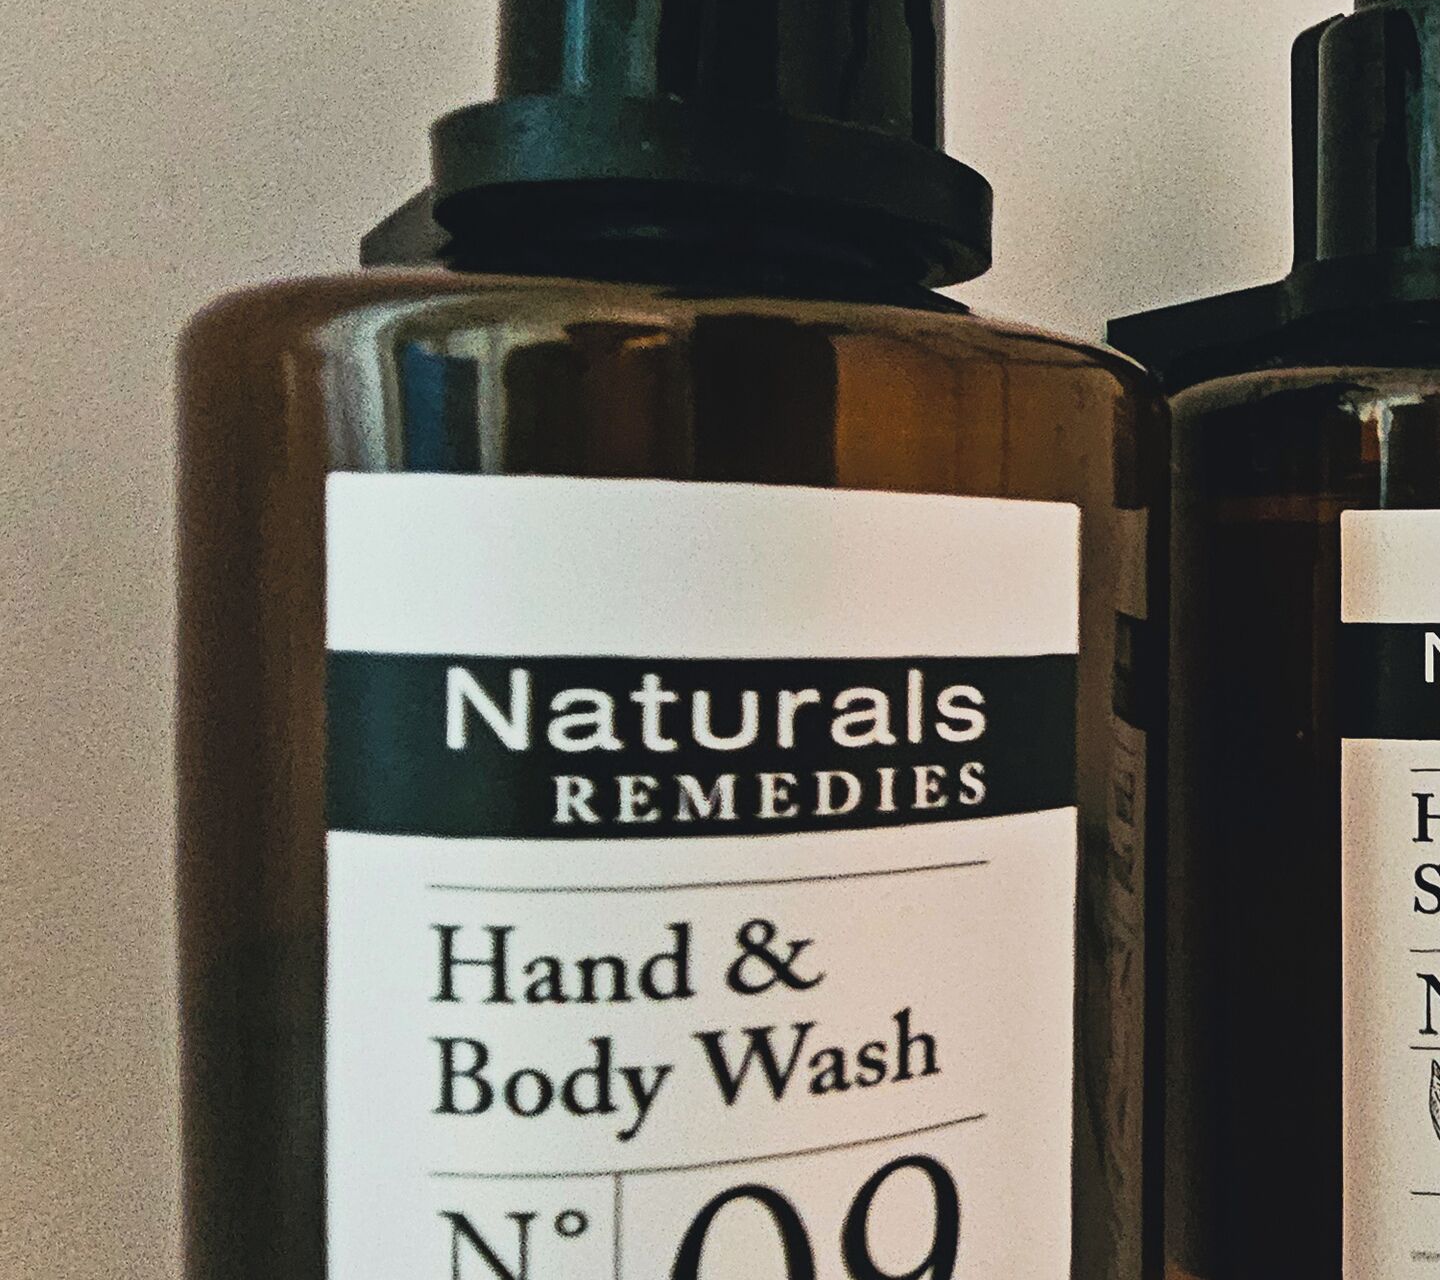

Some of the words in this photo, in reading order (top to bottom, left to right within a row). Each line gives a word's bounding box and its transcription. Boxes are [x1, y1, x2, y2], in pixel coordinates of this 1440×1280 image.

[444, 666, 986, 751] Naturals
[553, 763, 986, 825] REMEDIES
[431, 922, 694, 1004] Hand
[726, 919, 825, 995] &
[431, 1035, 673, 1141] Body
[695, 1008, 941, 1105] Wash
